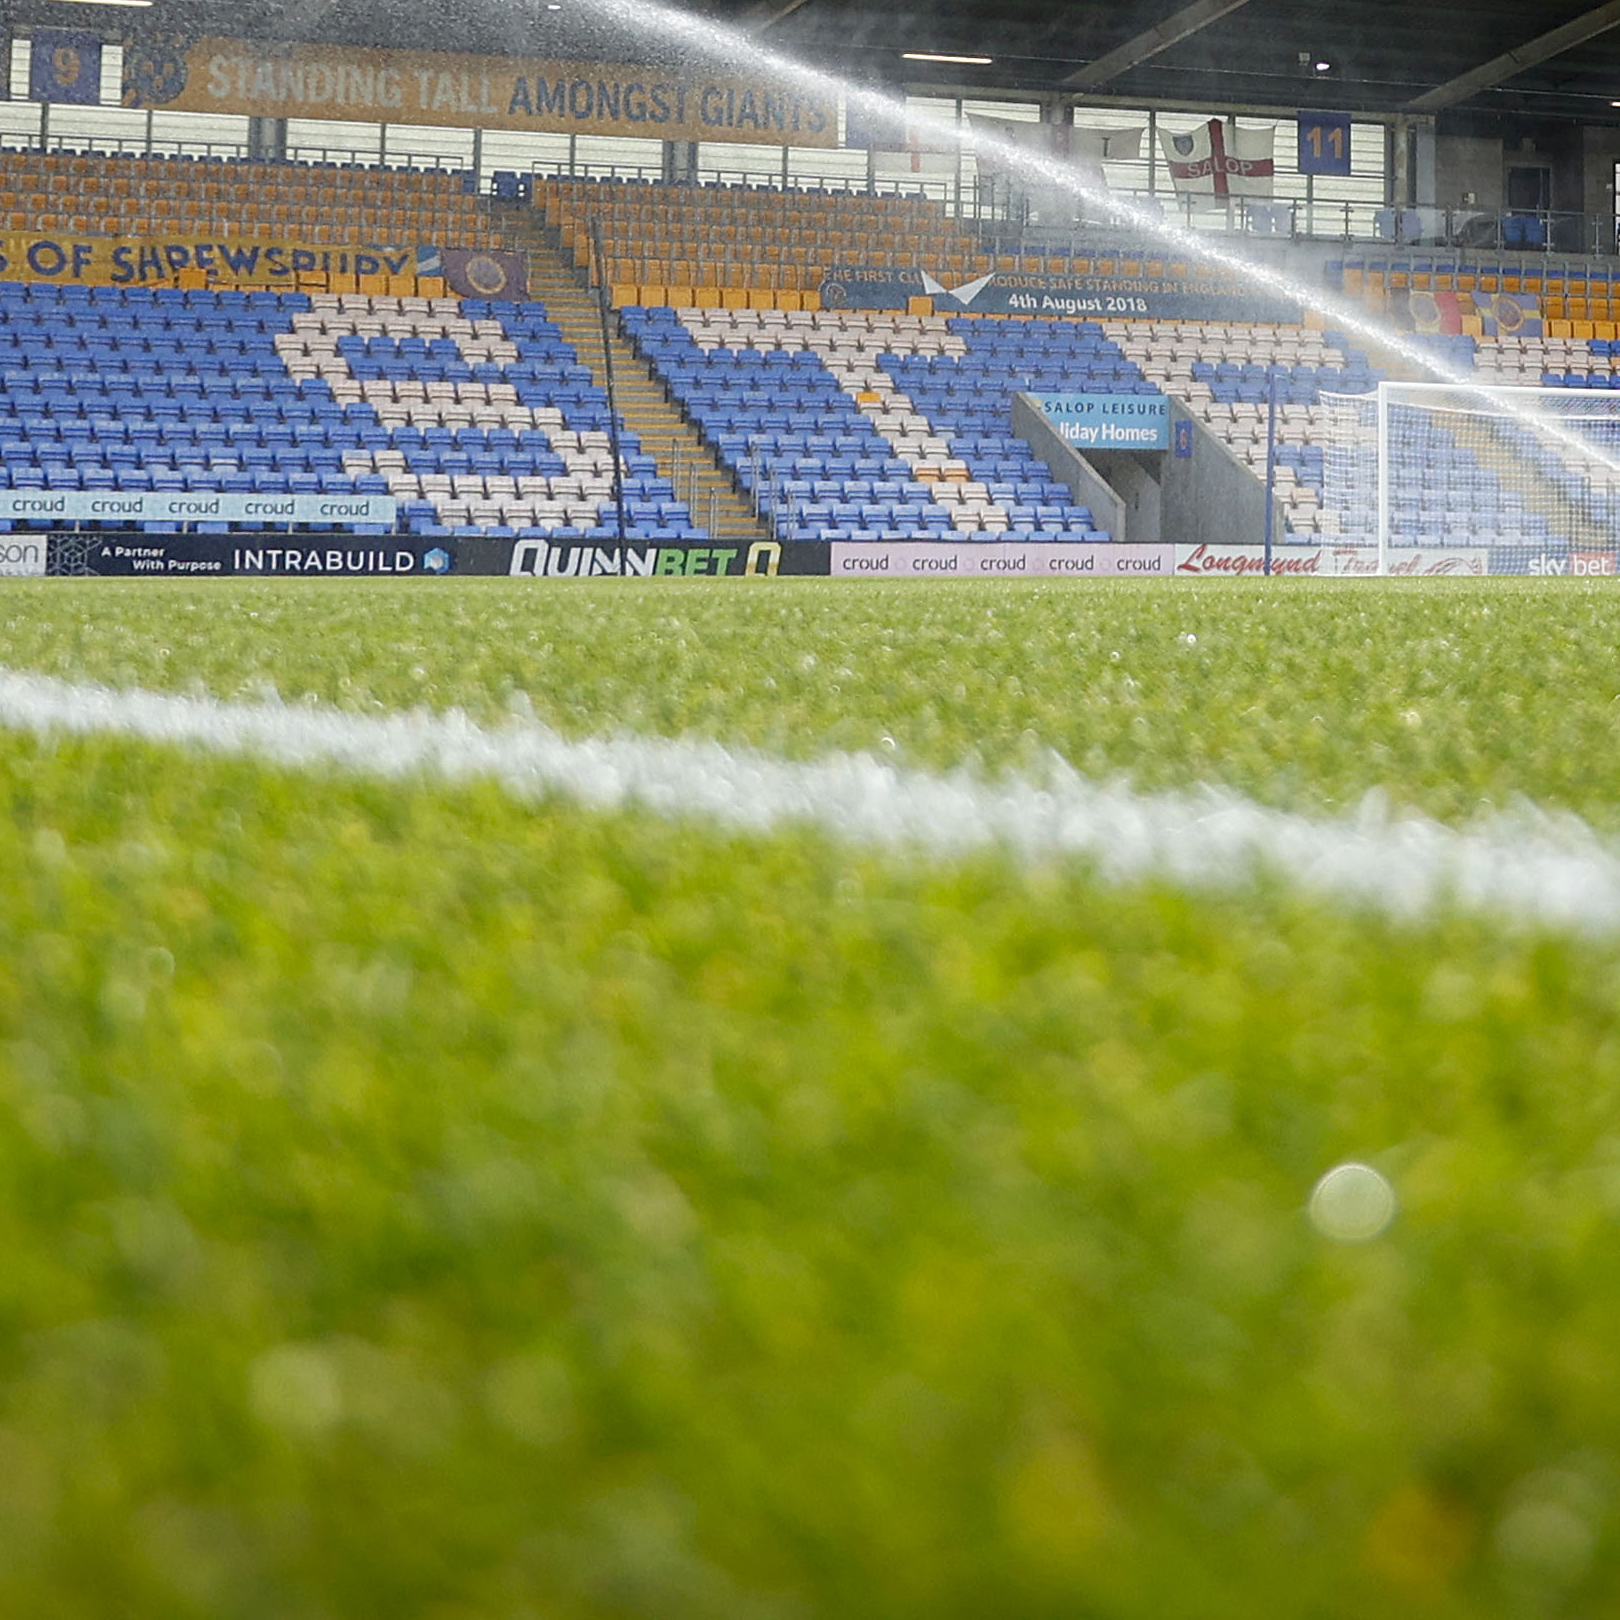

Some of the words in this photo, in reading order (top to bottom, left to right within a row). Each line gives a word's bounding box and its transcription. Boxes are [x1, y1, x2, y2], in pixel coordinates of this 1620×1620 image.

[53, 47, 79, 86] 9
[206, 51, 402, 110] STANDING
[415, 67, 498, 115] TALL
[507, 75, 688, 126] AMONGST
[699, 84, 827, 133] GIANTS
[1306, 126, 1343, 159] 11
[1187, 156, 1254, 178] SALOP
[26, 239, 93, 278] OF
[855, 270, 894, 283] FIRST
[1008, 294, 1038, 309] 4th
[1042, 295, 1102, 314] August
[1107, 297, 1147, 312] 2018
[1044, 400, 1095, 414] SALOP
[1102, 402, 1166, 416] LEISURE
[1059, 421, 1099, 443] liday
[1102, 423, 1158, 442] Homes
[12, 496, 66, 513] croud
[91, 498, 144, 514] croud
[168, 499, 220, 515] croud
[244, 500, 295, 516] croud
[320, 501, 370, 517] croud
[101, 547, 112, 558] A
[115, 546, 166, 558] Partner
[233, 548, 415, 573] INTRABUILD
[509, 539, 738, 577] QUINNBET
[132, 559, 165, 571] With
[168, 560, 221, 573] Purpose
[843, 554, 889, 571] croud
[912, 554, 958, 571] croud
[980, 554, 1026, 571] croud
[1049, 554, 1094, 571] croud
[1117, 554, 1161, 571] croud
[1528, 553, 1567, 575] sky
[1572, 553, 1610, 575] bet
